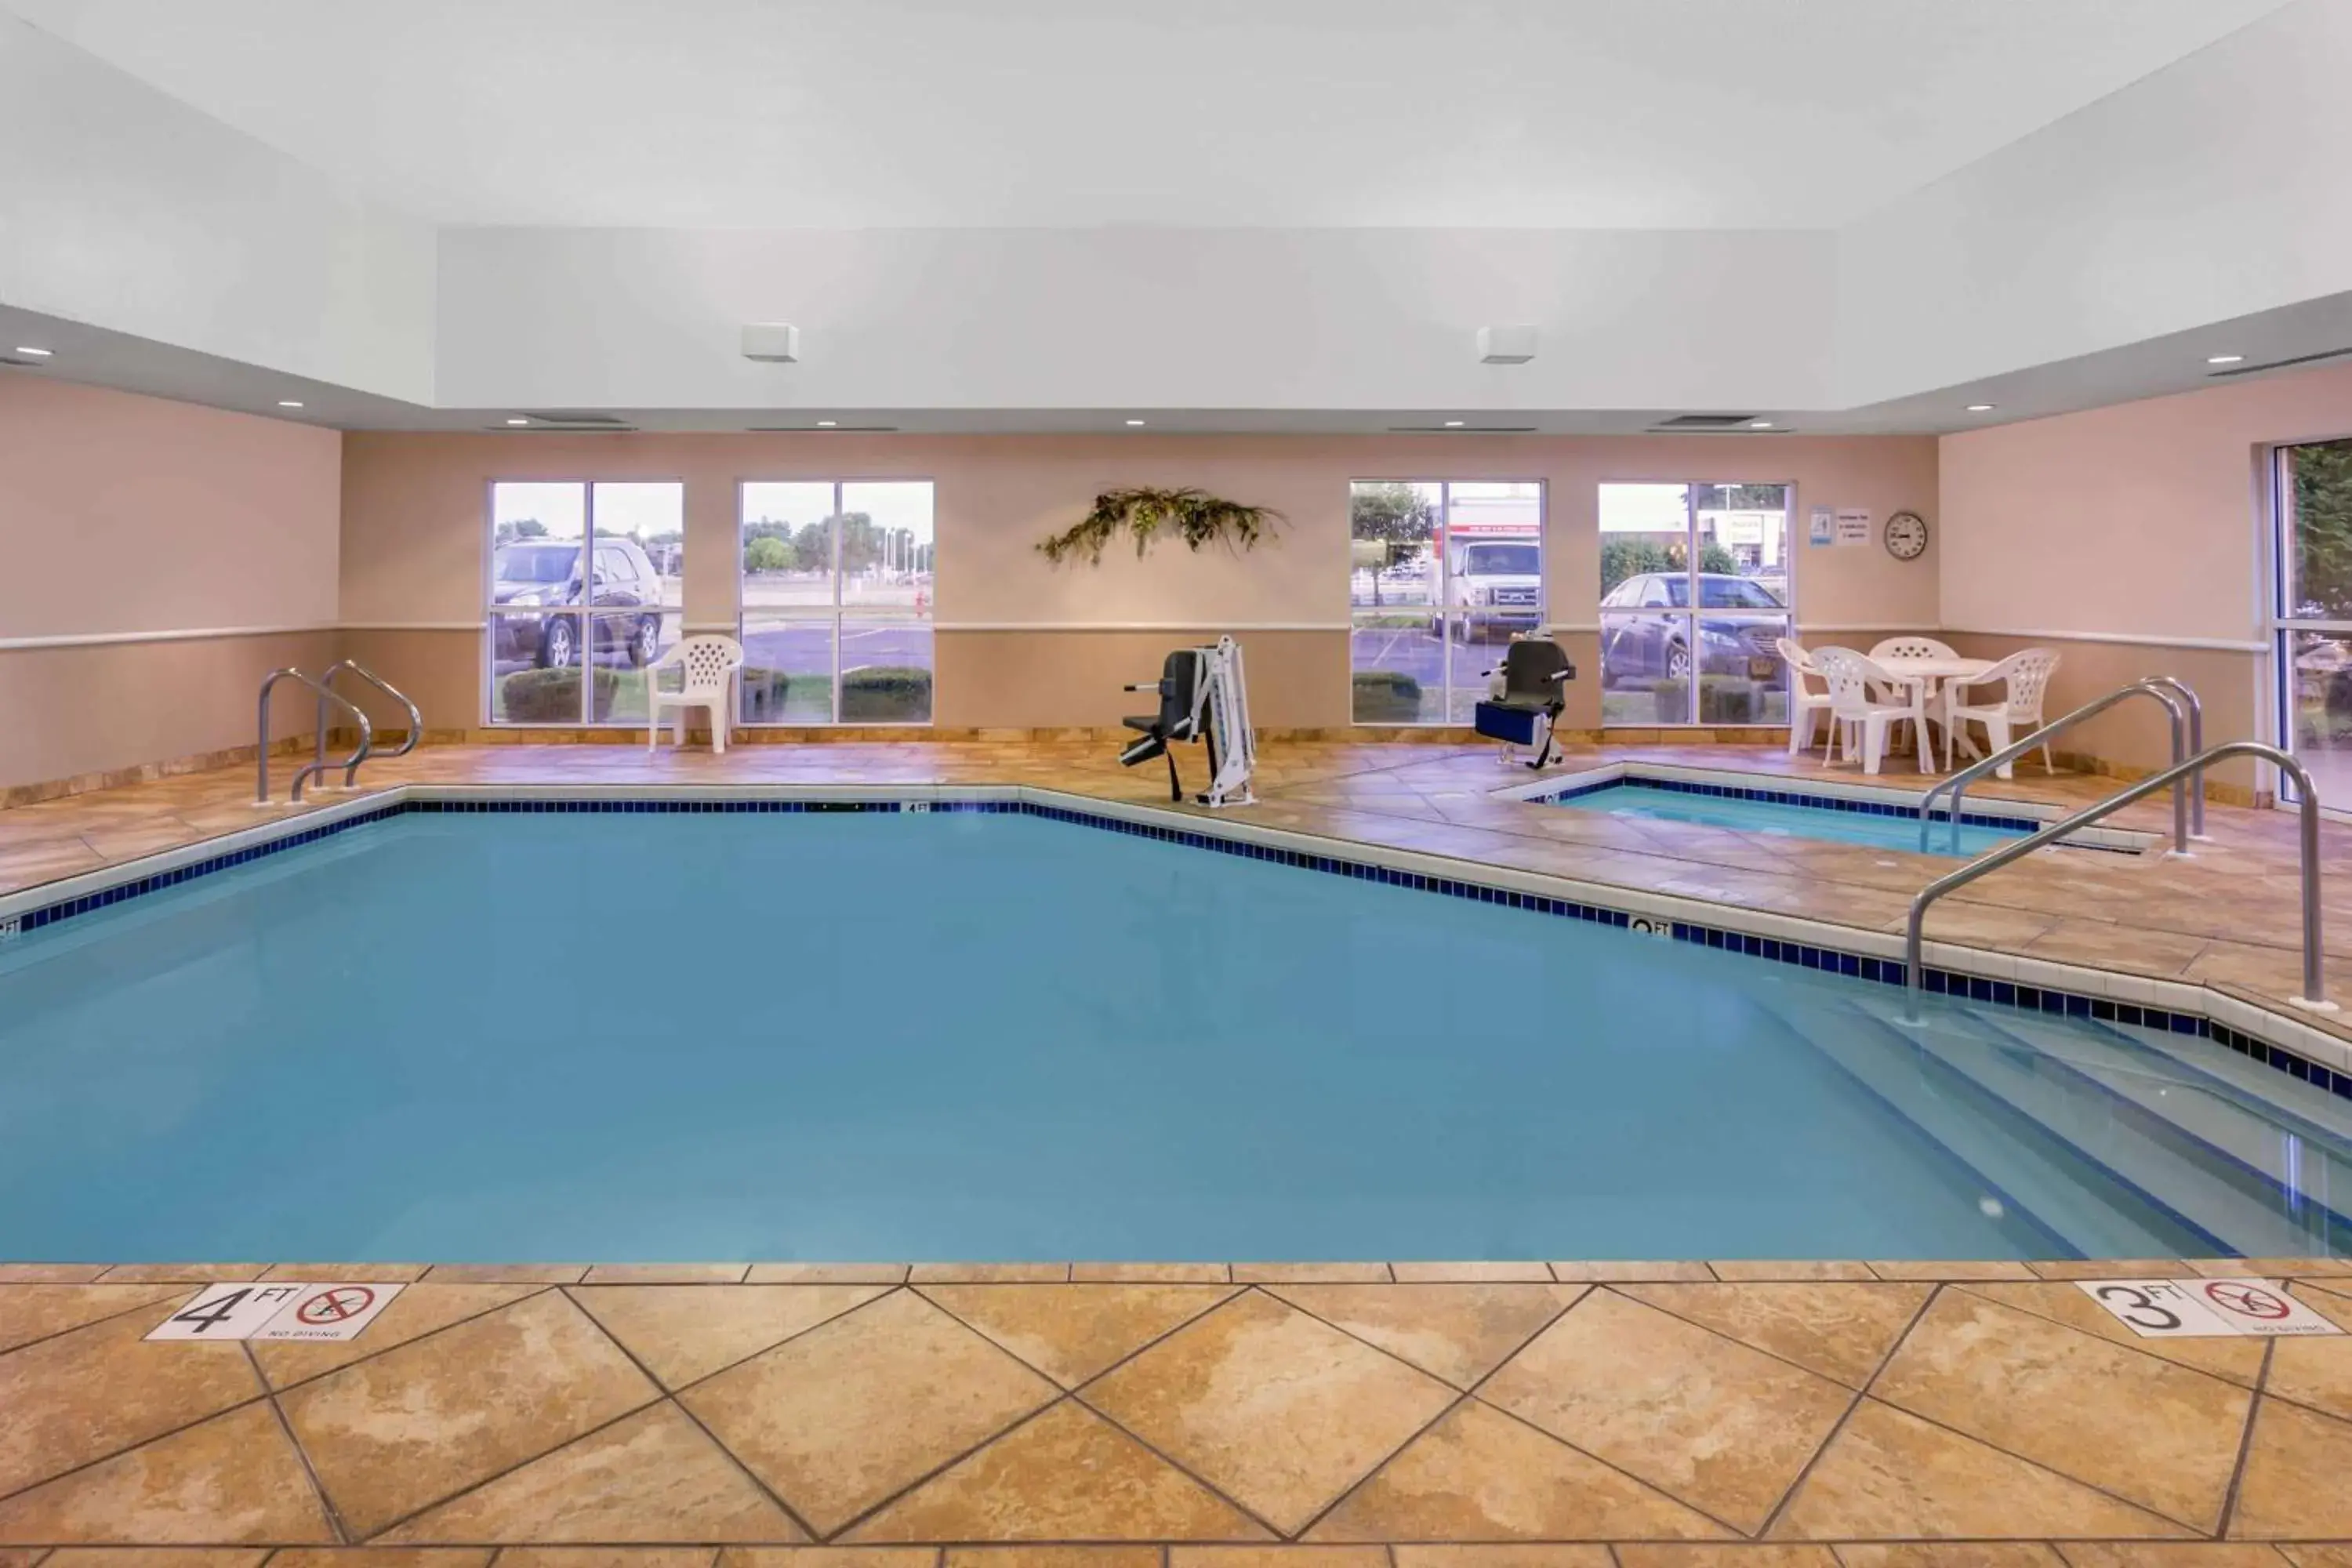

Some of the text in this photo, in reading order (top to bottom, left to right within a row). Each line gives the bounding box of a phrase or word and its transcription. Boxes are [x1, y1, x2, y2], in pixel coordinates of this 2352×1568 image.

[1655, 921, 1669, 935] FT
[172, 1287, 299, 1333] 4 FT
[2096, 1285, 2183, 1330] 3 FT
